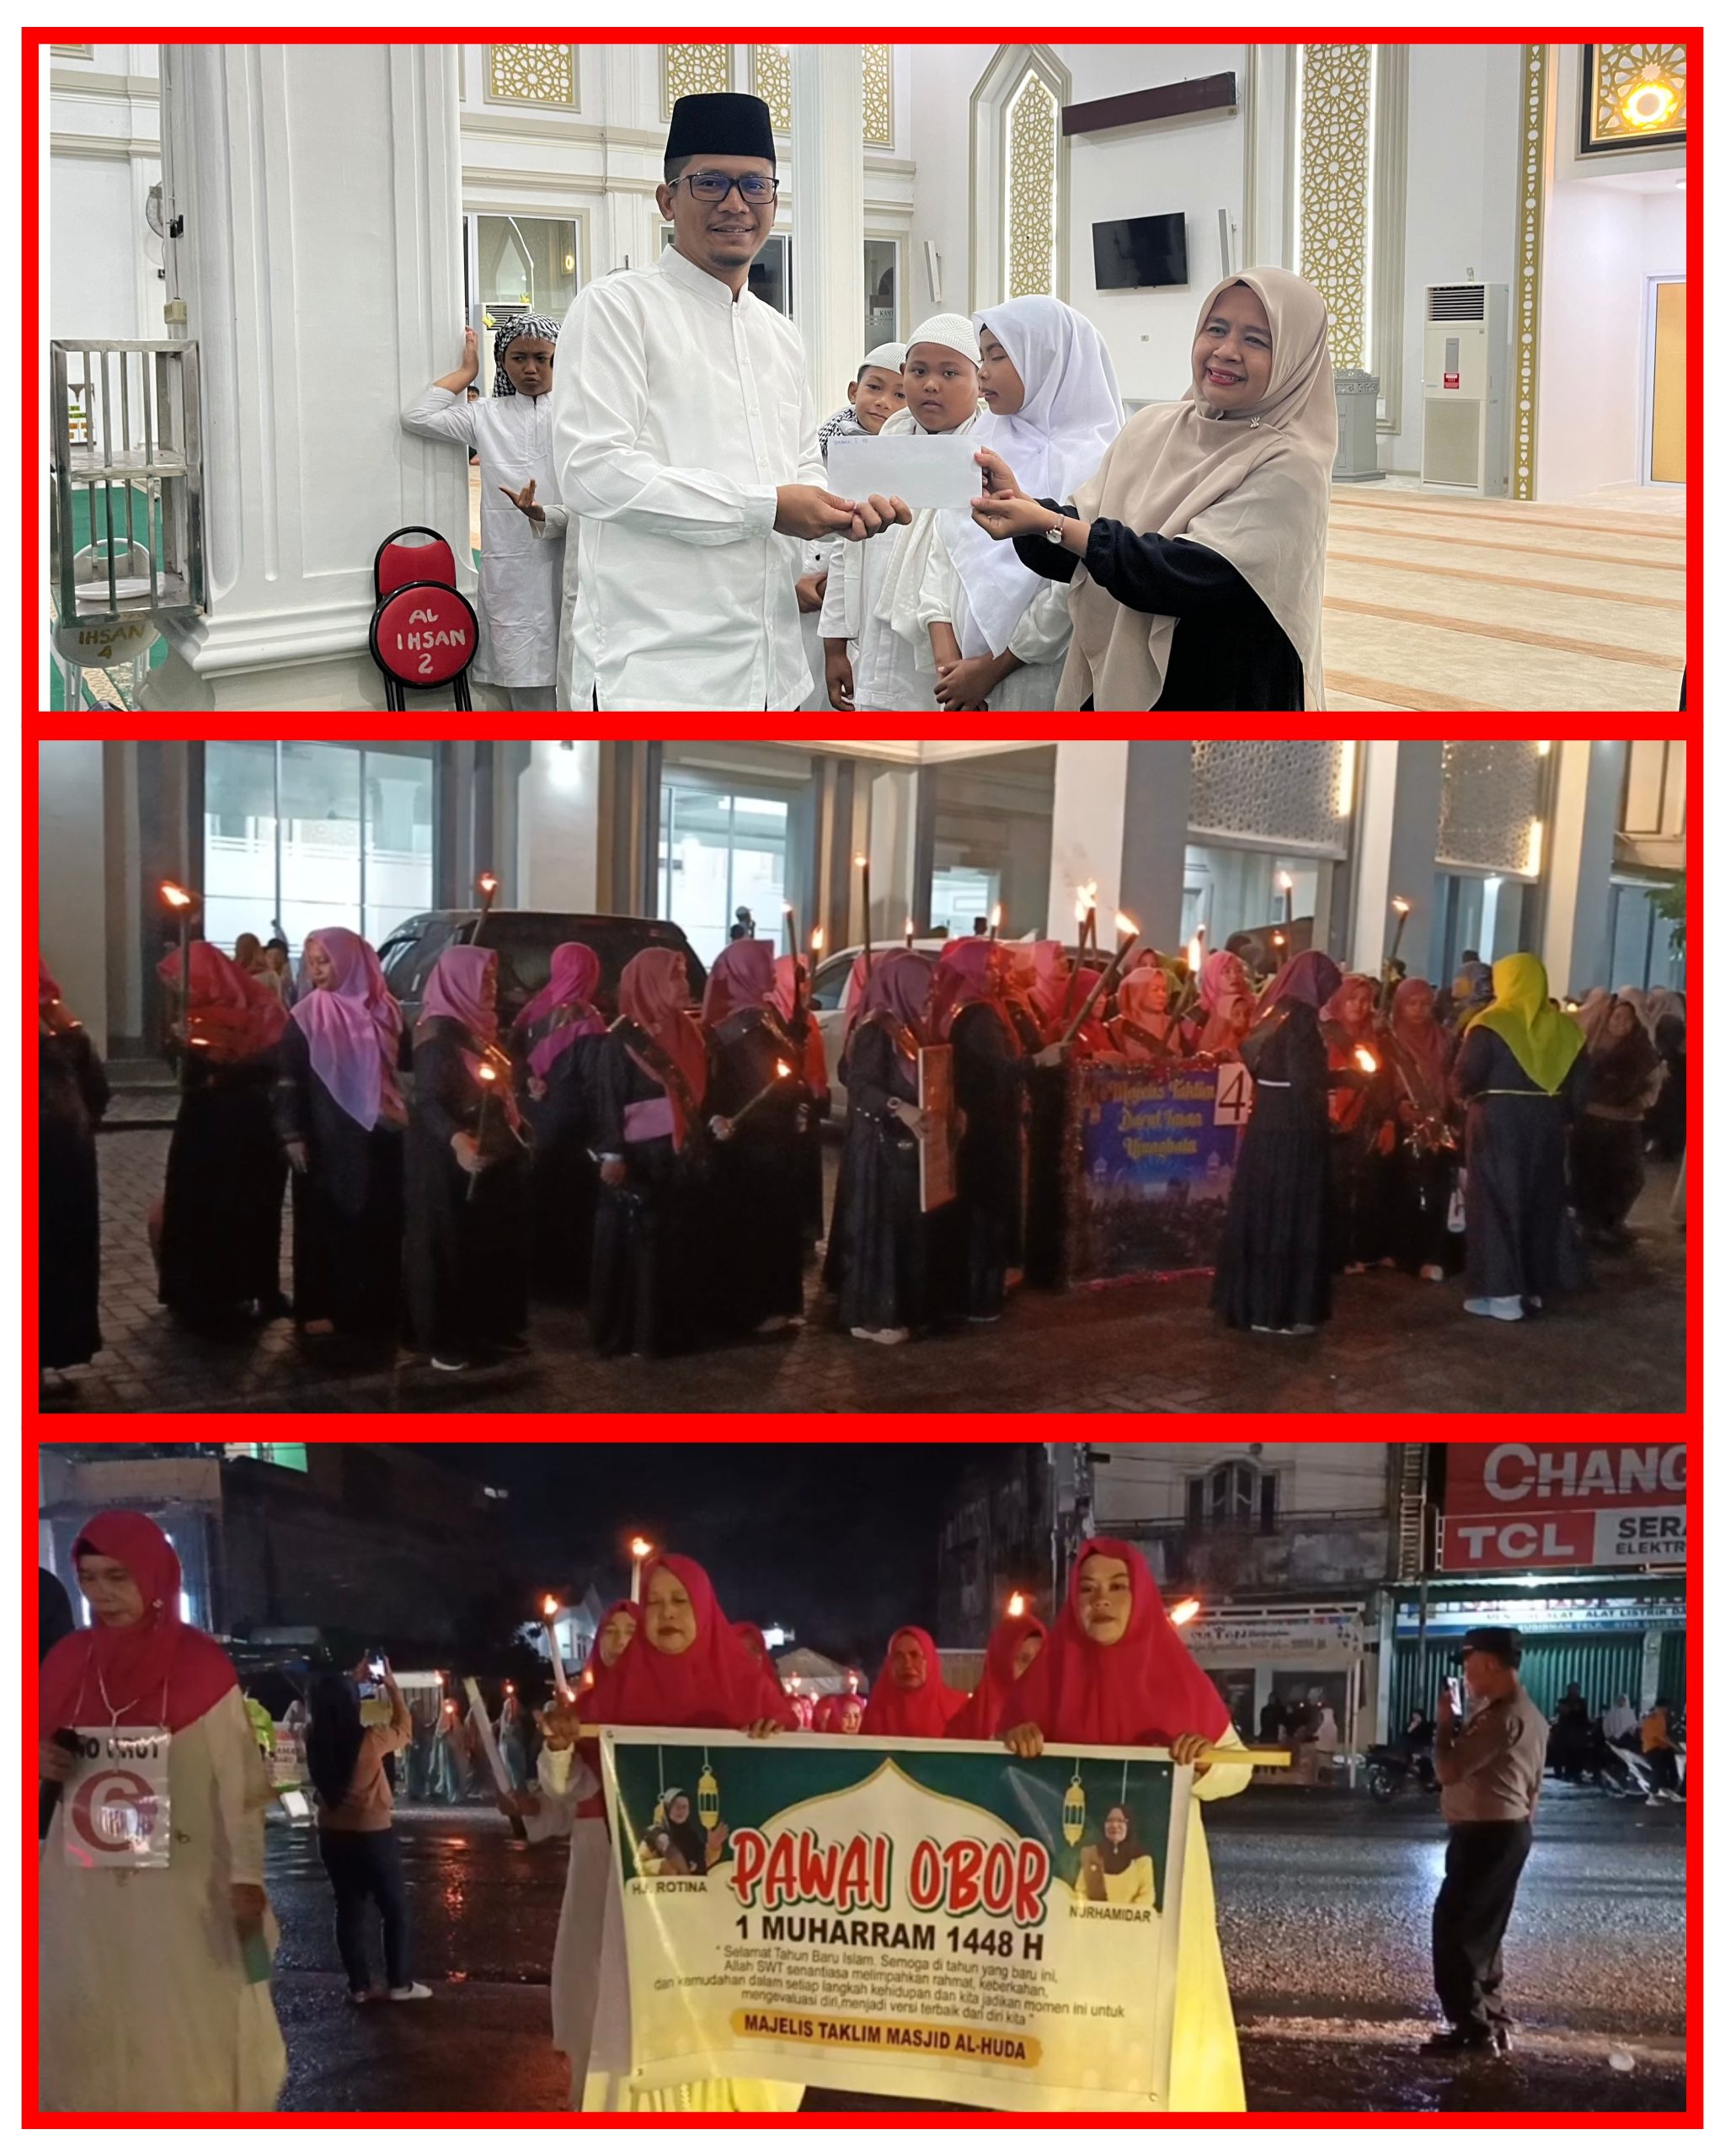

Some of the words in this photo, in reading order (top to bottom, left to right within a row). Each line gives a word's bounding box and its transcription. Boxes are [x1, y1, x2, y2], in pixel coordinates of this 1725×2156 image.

[409, 609, 438, 624] AL
[78, 625, 144, 644] IHSAN
[397, 629, 466, 650] IHSAN
[98, 645, 111, 659] 4
[418, 653, 433, 674] 2
[1218, 1070, 1247, 1121] 4
[1457, 1523, 1574, 1559] TCL
[1618, 1517, 1686, 1539] SER
[1616, 1540, 1686, 1556] ELEKTR
[1586, 1609, 1615, 1618] ALAT
[72, 1769, 158, 1852] 6
[656, 1881, 708, 1893] ROTINA
[729, 1827, 890, 1912] PAWAI
[910, 1837, 1049, 1925] OBOR
[1069, 1905, 1151, 1923] NURHAMIDAR
[735, 1915, 749, 1940] 1
[762, 1915, 935, 1951] MUHARRAM
[947, 1925, 1012, 1957] 1448
[1023, 1934, 1044, 1961] H
[724, 1946, 772, 1959] Selamat
[774, 1947, 809, 1962] Tahun
[811, 1950, 839, 1964] Baru
[843, 1952, 876, 1967] Islam.
[881, 1954, 930, 1972] Semoga
[932, 1960, 943, 1972] di
[946, 1961, 979, 1973] tahun
[981, 1965, 1009, 1980] yang
[1012, 1967, 1038, 1981] baru
[1041, 1968, 1058, 1983] ini,
[724, 1960, 754, 1972] Allah
[756, 1961, 783, 1974] SWT
[787, 1963, 849, 1979] senantiasa
[852, 1969, 930, 1986] melimpahkan
[979, 1980, 1049, 1998] keberkahan,
[741, 1989, 817, 2006] mengevaluasi
[889, 2000, 918, 2012] versi
[920, 2002, 960, 2016] terbaik
[963, 2007, 984, 2020] dari
[986, 2009, 1004, 2022] diri
[1006, 2011, 1026, 2025] kita
[749, 1976, 783, 1988] dalam
[785, 1977, 820, 1993] setiap
[821, 1980, 868, 1996] langkah
[871, 1984, 931, 2001] kehidupan
[933, 1989, 956, 2003] dan
[959, 1991, 979, 2004] kita
[981, 1994, 1021, 2009] jadikan
[1023, 1999, 1070, 2014] momen
[1073, 2002, 1087, 2015] ini
[1090, 2004, 1125, 2018] untuk
[745, 2015, 814, 2038] MAJELIS
[818, 2021, 882, 2044] TAKLIM
[886, 2026, 951, 2050] MASJID
[955, 2033, 1027, 2060] AL-HUDA
